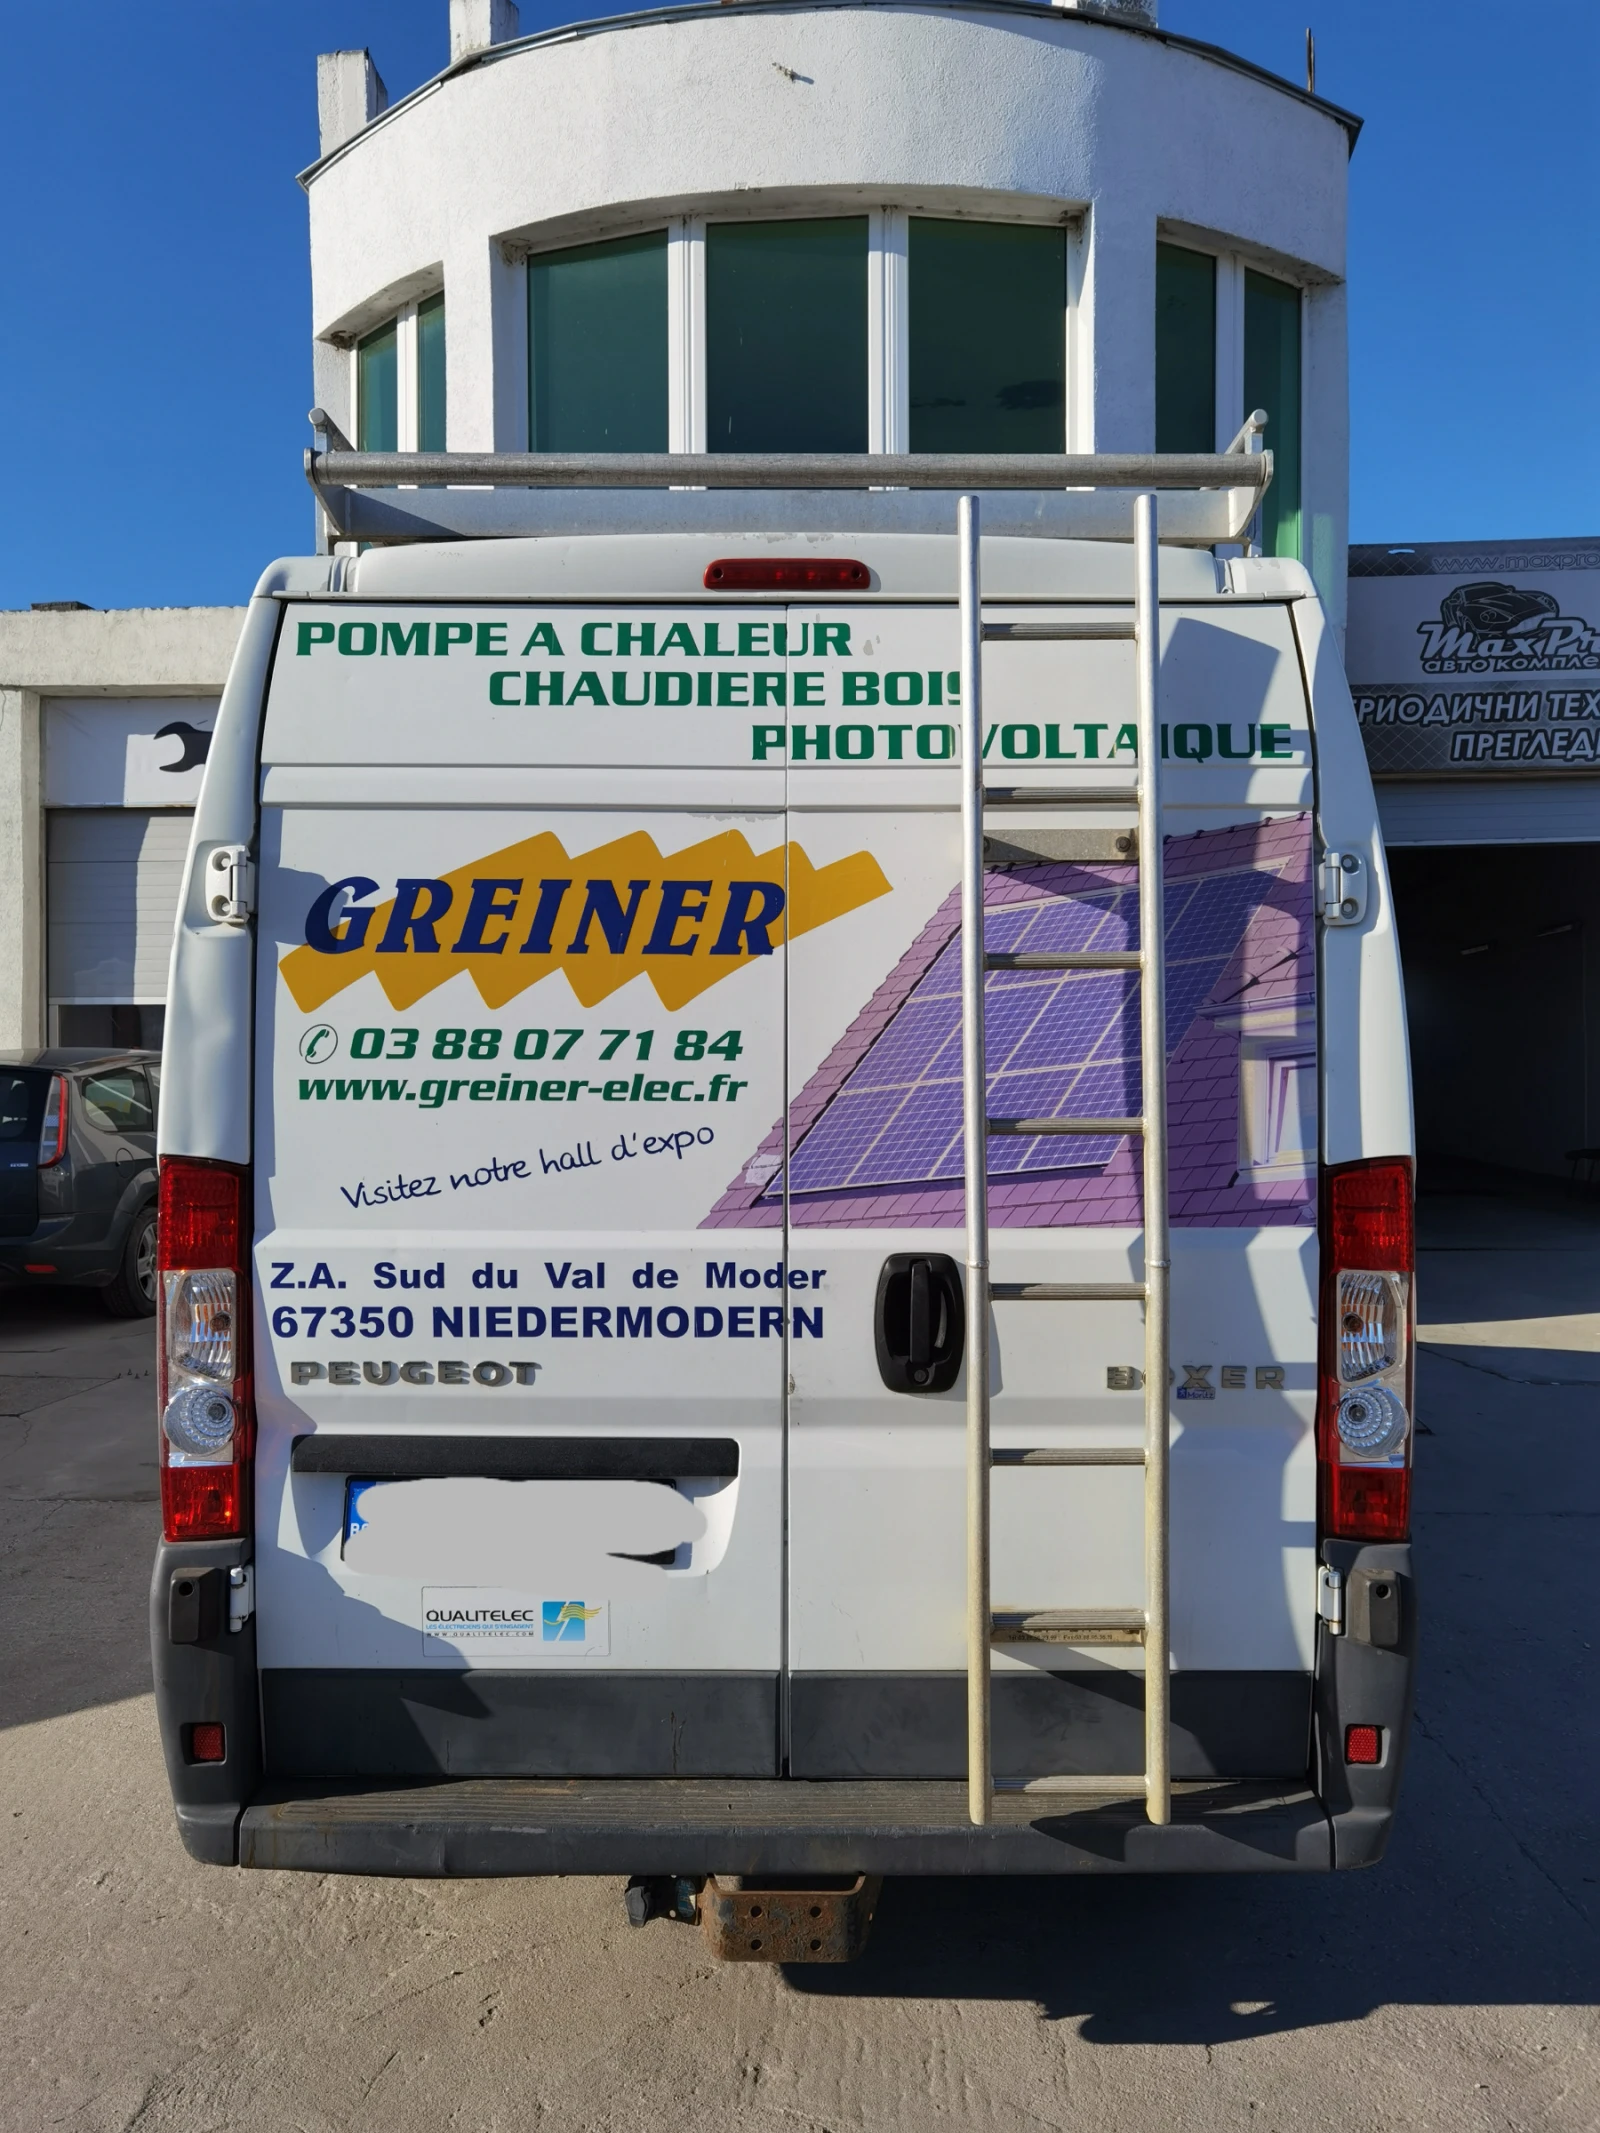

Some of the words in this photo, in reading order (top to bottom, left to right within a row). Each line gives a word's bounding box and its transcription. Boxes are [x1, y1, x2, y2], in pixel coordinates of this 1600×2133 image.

[296, 621, 507, 657] POMPE
[521, 622, 564, 656] A
[580, 622, 852, 657] CHALEUR
[489, 671, 826, 707] CHAUDIERE
[1353, 694, 1540, 725] РИОДИЧНИ
[1453, 731, 1600, 759] ПРЕГЛЕД
[304, 876, 786, 956] GREINER
[349, 1028, 420, 1060] 03
[431, 1028, 502, 1060] 88
[513, 1028, 584, 1061] 07
[599, 1029, 655, 1061] 71
[673, 1029, 743, 1062] 84
[298, 1072, 748, 1109] www.greiner-elec.fr
[339, 1173, 443, 1209] Visitez
[449, 1157, 532, 1190] notre
[538, 1140, 603, 1175] hall
[610, 1126, 715, 1161] d'expo
[270, 1262, 347, 1289] Z.A.
[373, 1262, 446, 1289] Sud
[472, 1262, 519, 1289] du
[544, 1262, 605, 1289] Val
[632, 1262, 679, 1289] de
[706, 1262, 828, 1290] Moder
[272, 1306, 414, 1338] 67350
[432, 1305, 824, 1339] NIEDERMODERN
[291, 1360, 541, 1387] PEUGEOT
[1106, 1365, 1286, 1390] BXER
[426, 1609, 534, 1622] QUALITELEC
